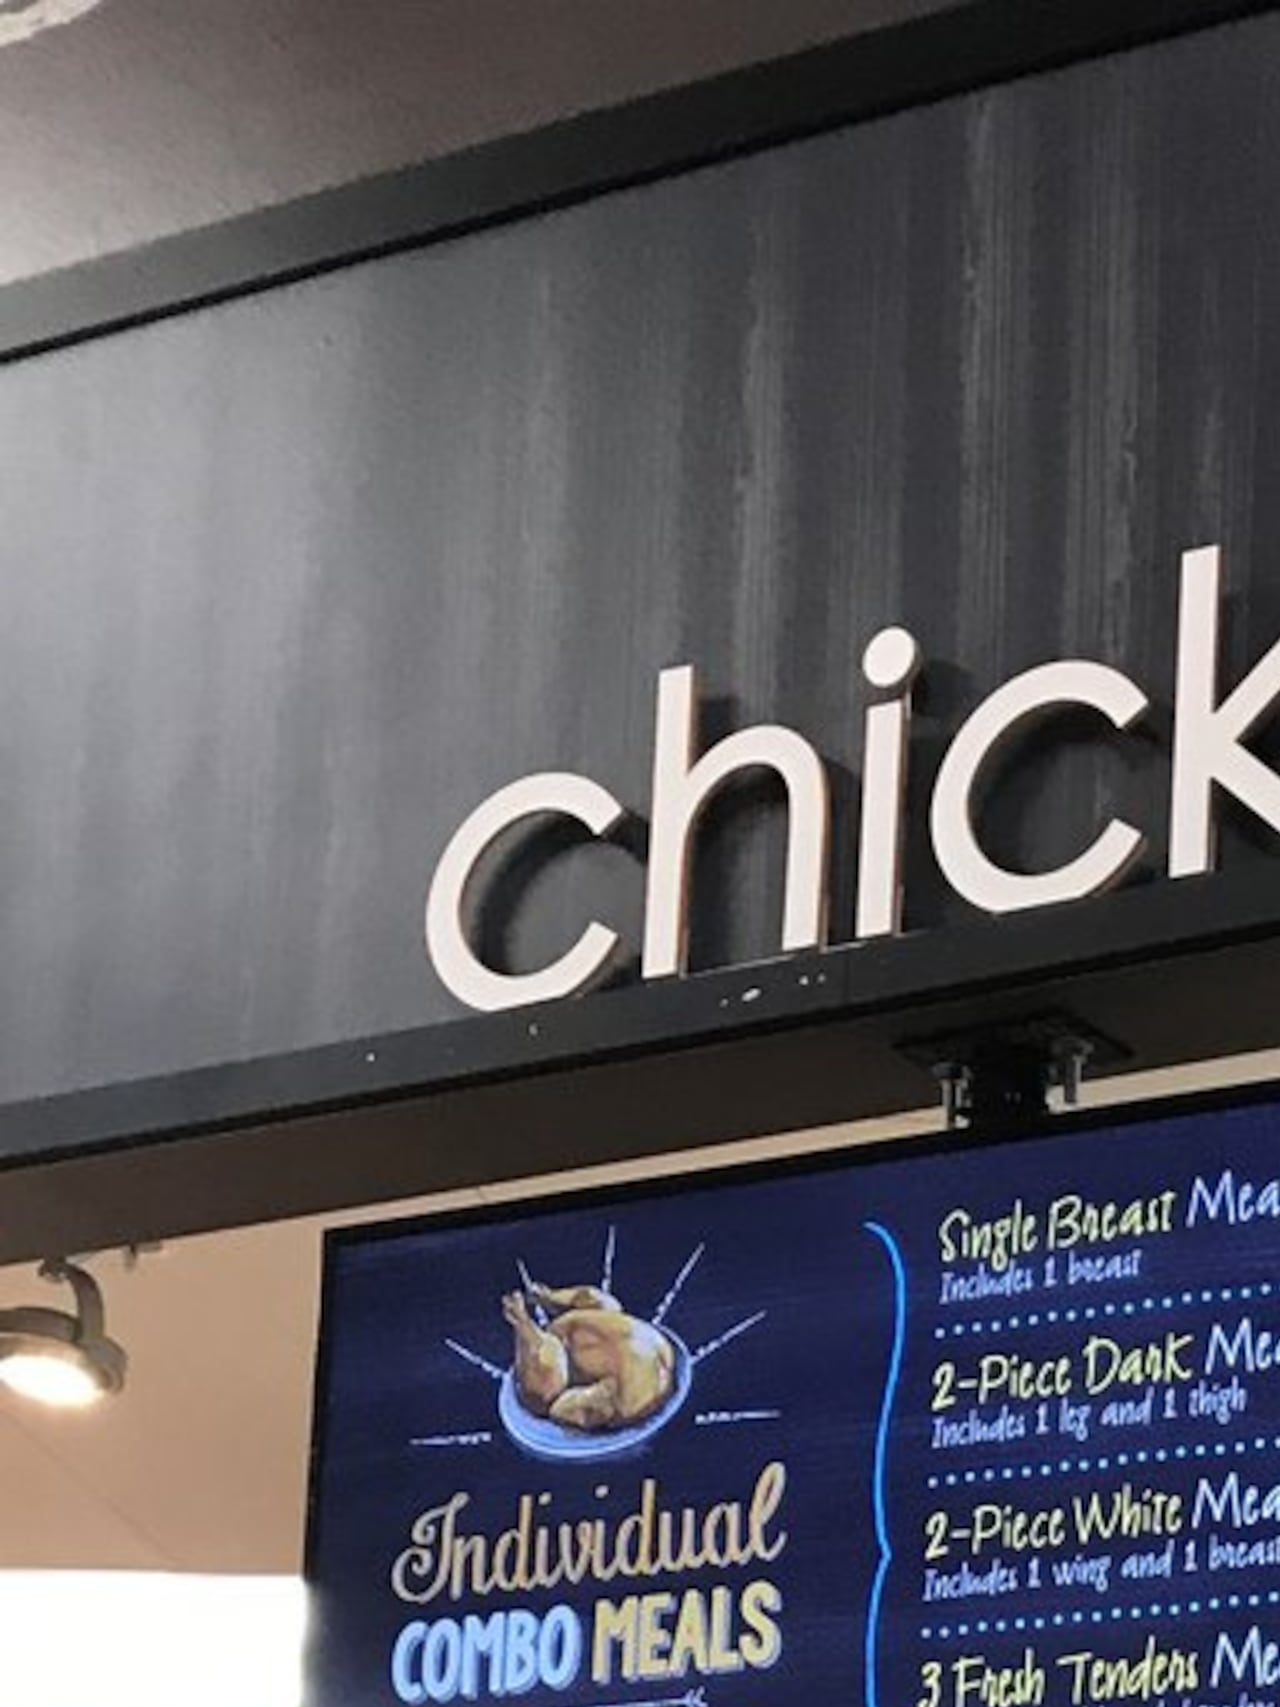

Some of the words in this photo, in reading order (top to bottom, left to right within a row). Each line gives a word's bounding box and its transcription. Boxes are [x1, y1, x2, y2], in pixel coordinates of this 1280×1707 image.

[938, 1199, 1038, 1274] Single
[1048, 1190, 1174, 1251] Breast
[938, 1267, 1035, 1306] Includes
[1043, 1260, 1058, 1287] 1
[1068, 1249, 1142, 1284] breast
[931, 1354, 1074, 1413] 2-Piece
[1084, 1330, 1194, 1389] Dark
[931, 1408, 1028, 1450] Includes
[1035, 1406, 1049, 1435] 1
[1059, 1400, 1089, 1440] leg
[1103, 1389, 1152, 1425] and
[1162, 1391, 1177, 1420] 1
[1189, 1376, 1247, 1425] thigh
[392, 1462, 788, 1603] Individual
[924, 1503, 1065, 1561] 2-Piece
[1074, 1482, 1184, 1542] White
[922, 1561, 1018, 1602] Includes
[1026, 1556, 1042, 1586] 1
[1052, 1549, 1111, 1593] wing
[1123, 1542, 1174, 1580] and
[1184, 1541, 1198, 1571] 1
[392, 1603, 581, 1705] COMBO
[592, 1577, 783, 1686] MEALS
[1057, 1635, 1200, 1700] Tenders
